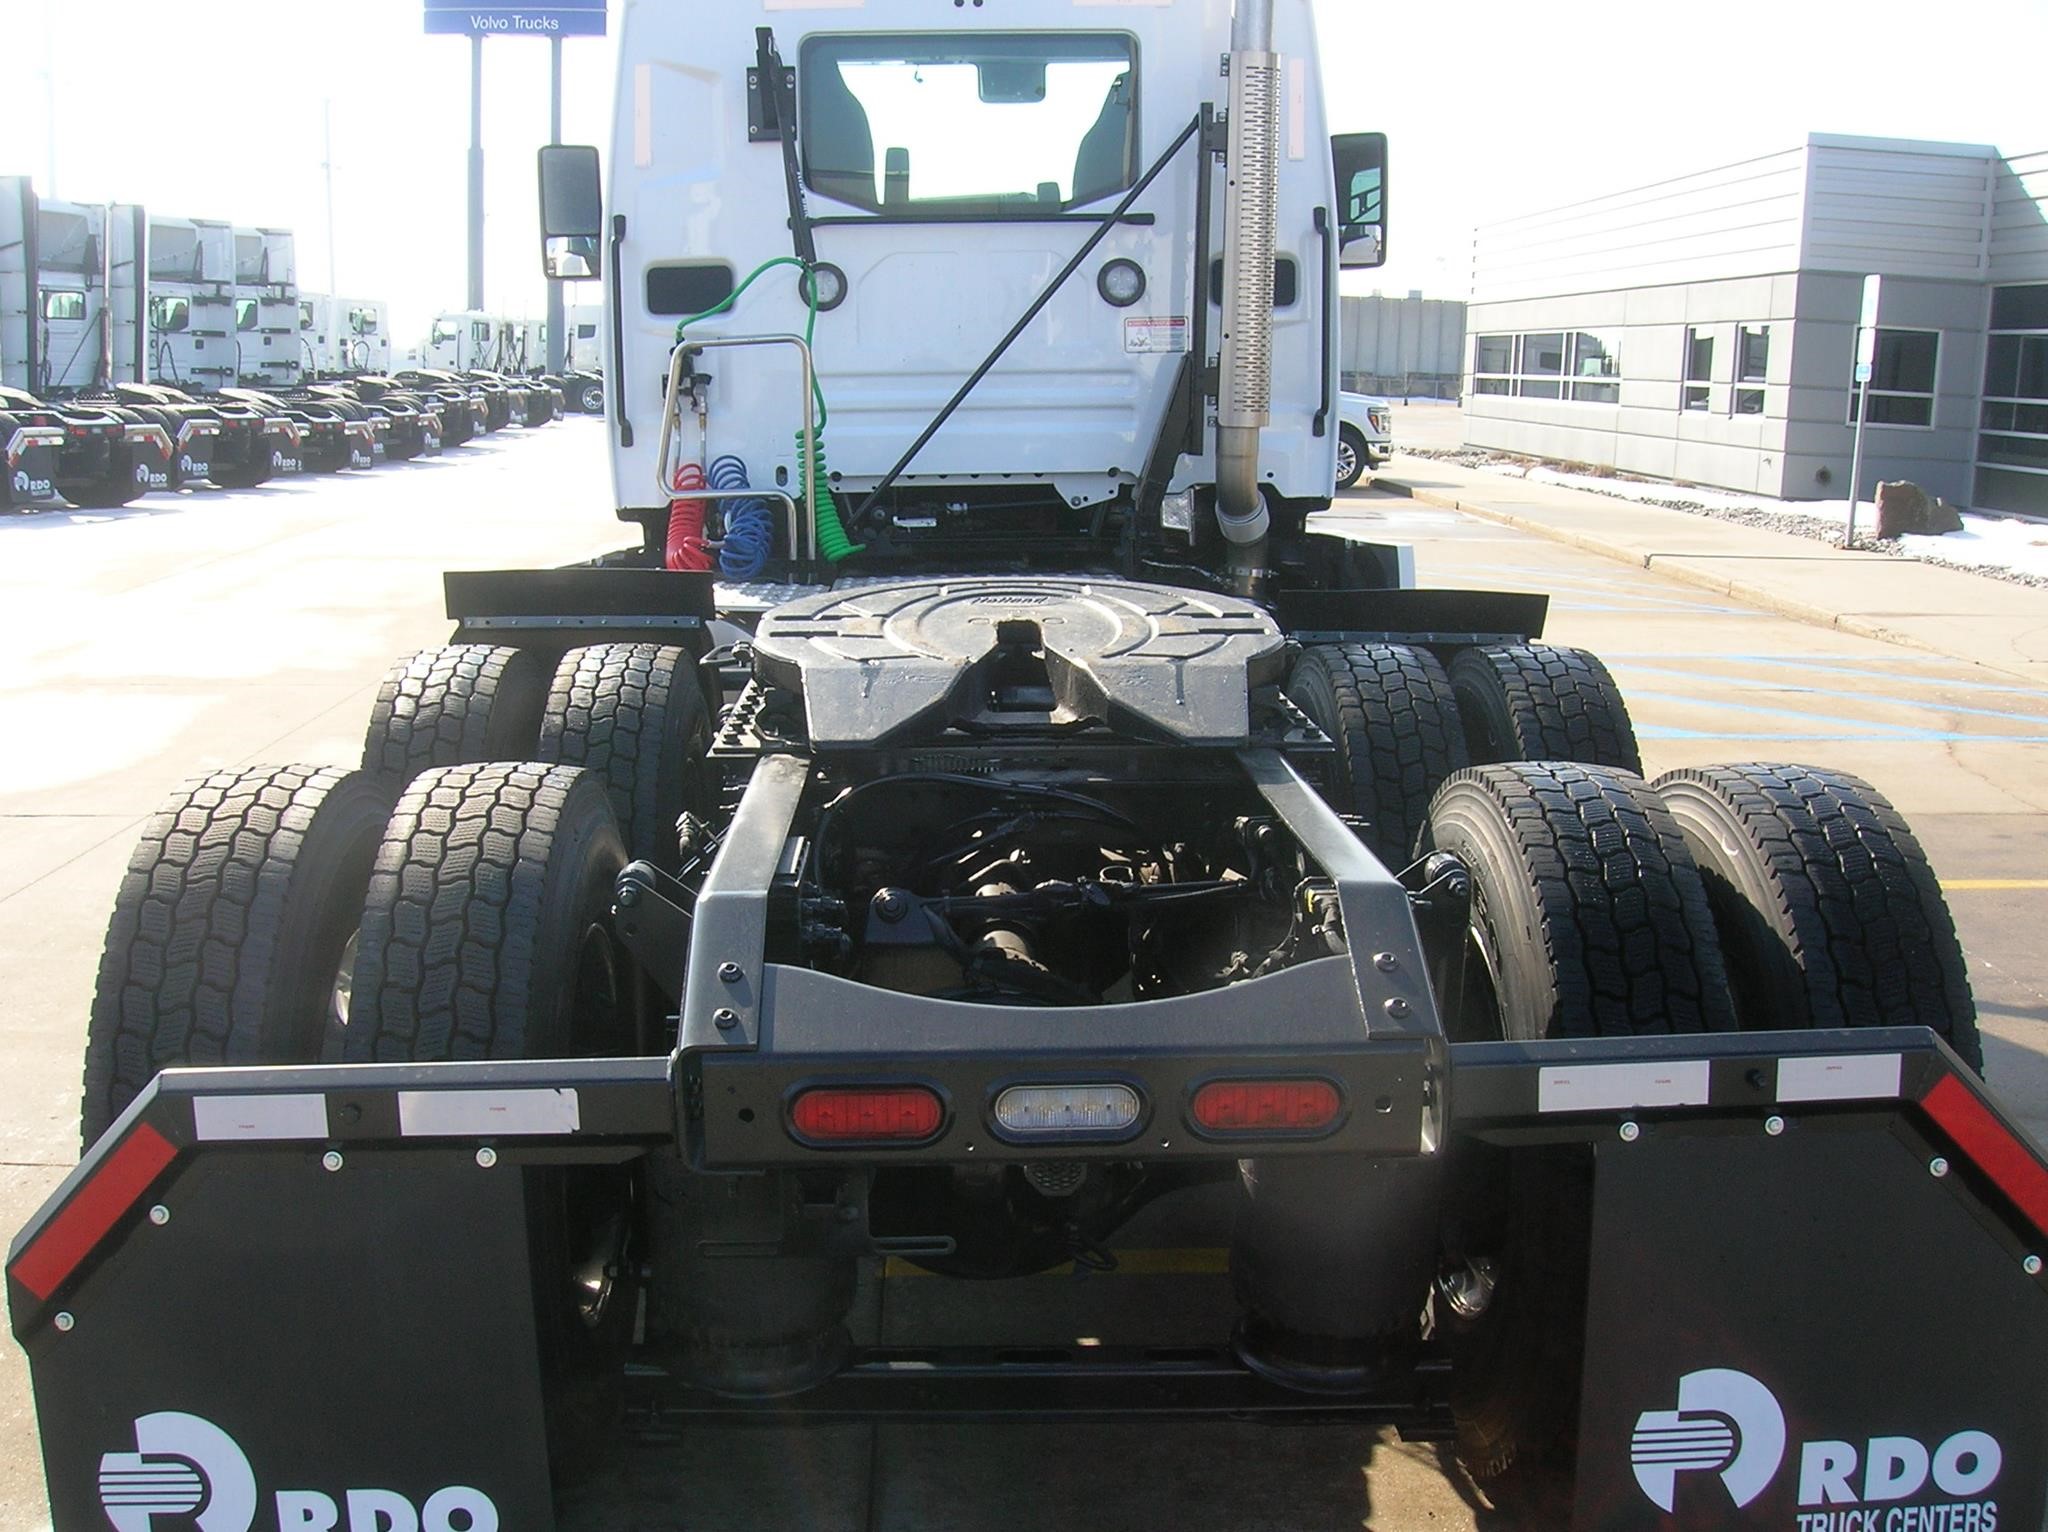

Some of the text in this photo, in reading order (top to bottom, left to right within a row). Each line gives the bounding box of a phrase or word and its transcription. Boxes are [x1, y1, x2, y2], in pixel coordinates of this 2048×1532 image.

[471, 15, 559, 30] Volvo Trucks
[193, 462, 208, 471] RDO
[30, 479, 50, 491] RDO
[150, 473, 167, 482] RDO
[1798, 1430, 2002, 1506] RDO
[276, 1485, 499, 1532] RDO
[1796, 1501, 1998, 1532] TRUCK CENTERS
